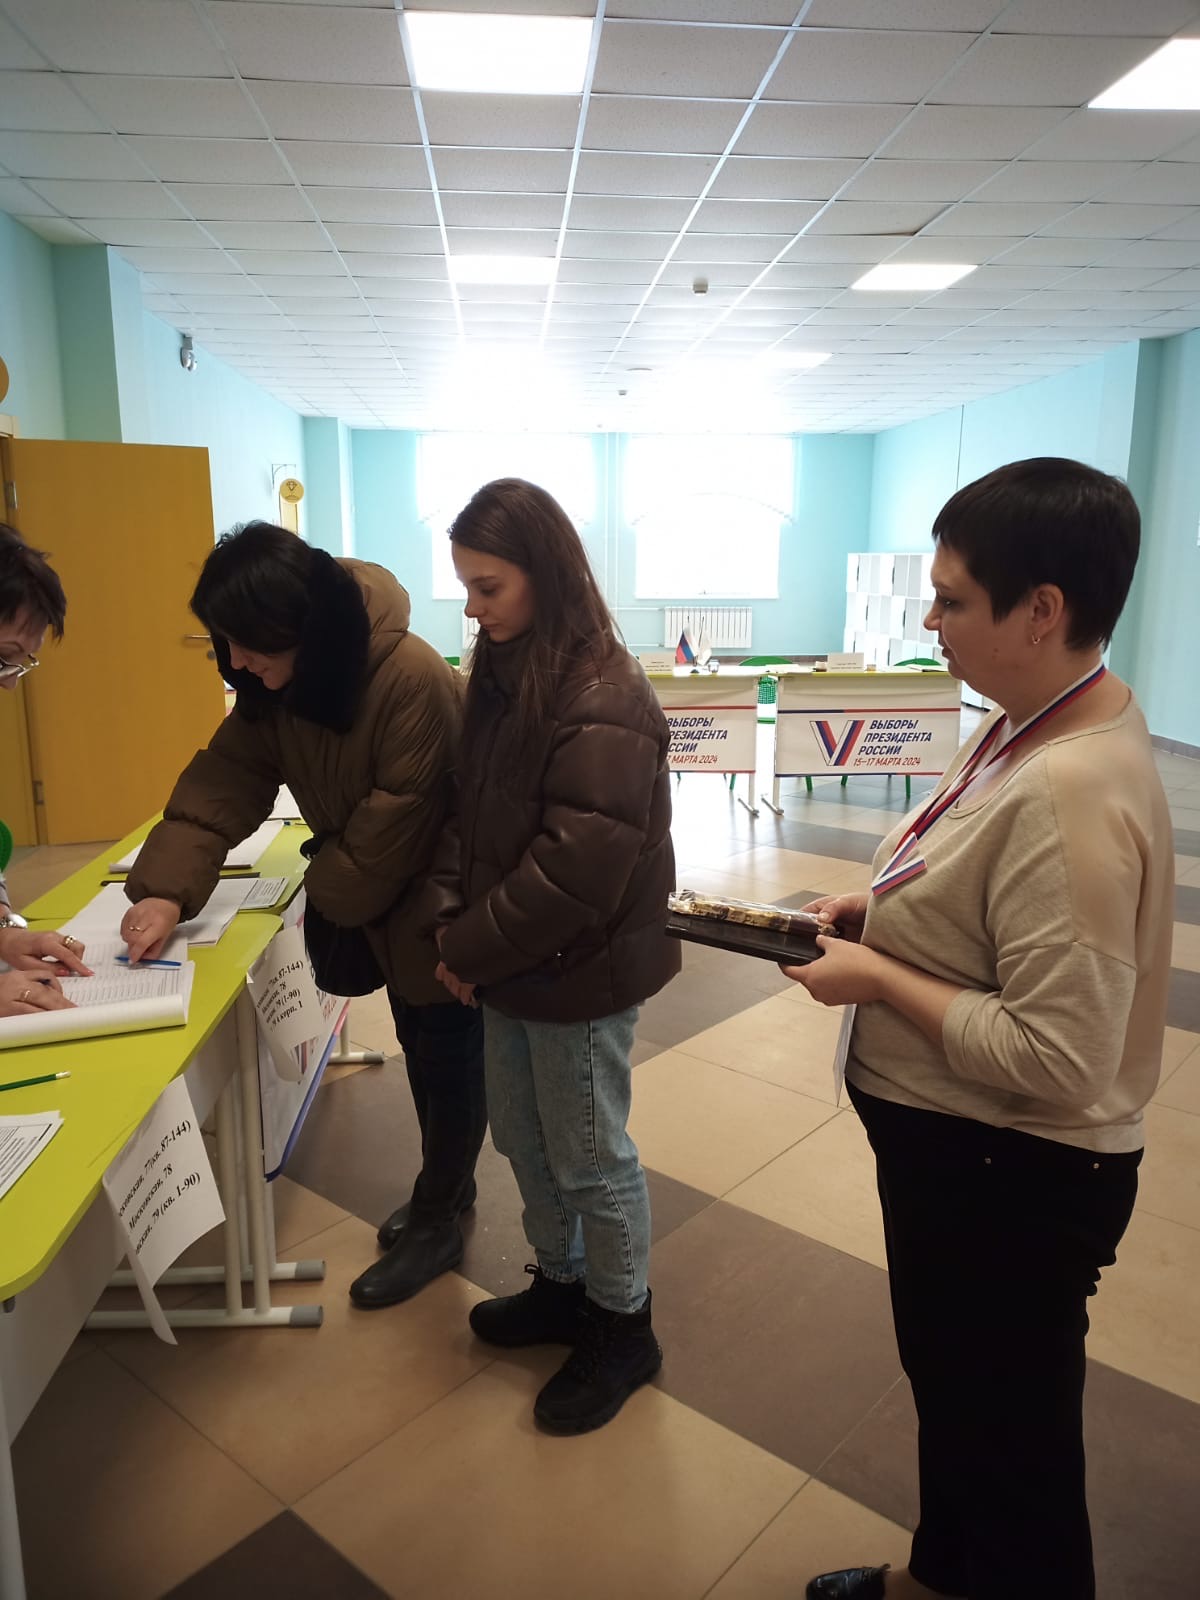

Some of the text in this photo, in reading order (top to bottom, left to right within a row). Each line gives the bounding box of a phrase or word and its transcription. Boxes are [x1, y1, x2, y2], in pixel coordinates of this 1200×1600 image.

[667, 717, 714, 727] ВЫБОРЫ
[869, 719, 919, 730] ВЫБОРЫ
[669, 730, 728, 741] РЕЗИДЕНТА
[864, 732, 932, 743] ПРЕЗИДЕНТА
[668, 742, 698, 753] ССИИ
[858, 745, 902, 756] РОССИИ
[671, 755, 698, 764] МАРТА
[698, 755, 718, 764] 2024
[876, 758, 902, 767] МАРТА
[902, 757, 921, 766] 2024
[160, 1119, 192, 1153] 87-144)
[163, 1163, 173, 1179] 78
[176, 1171, 201, 1198] 1-90)
